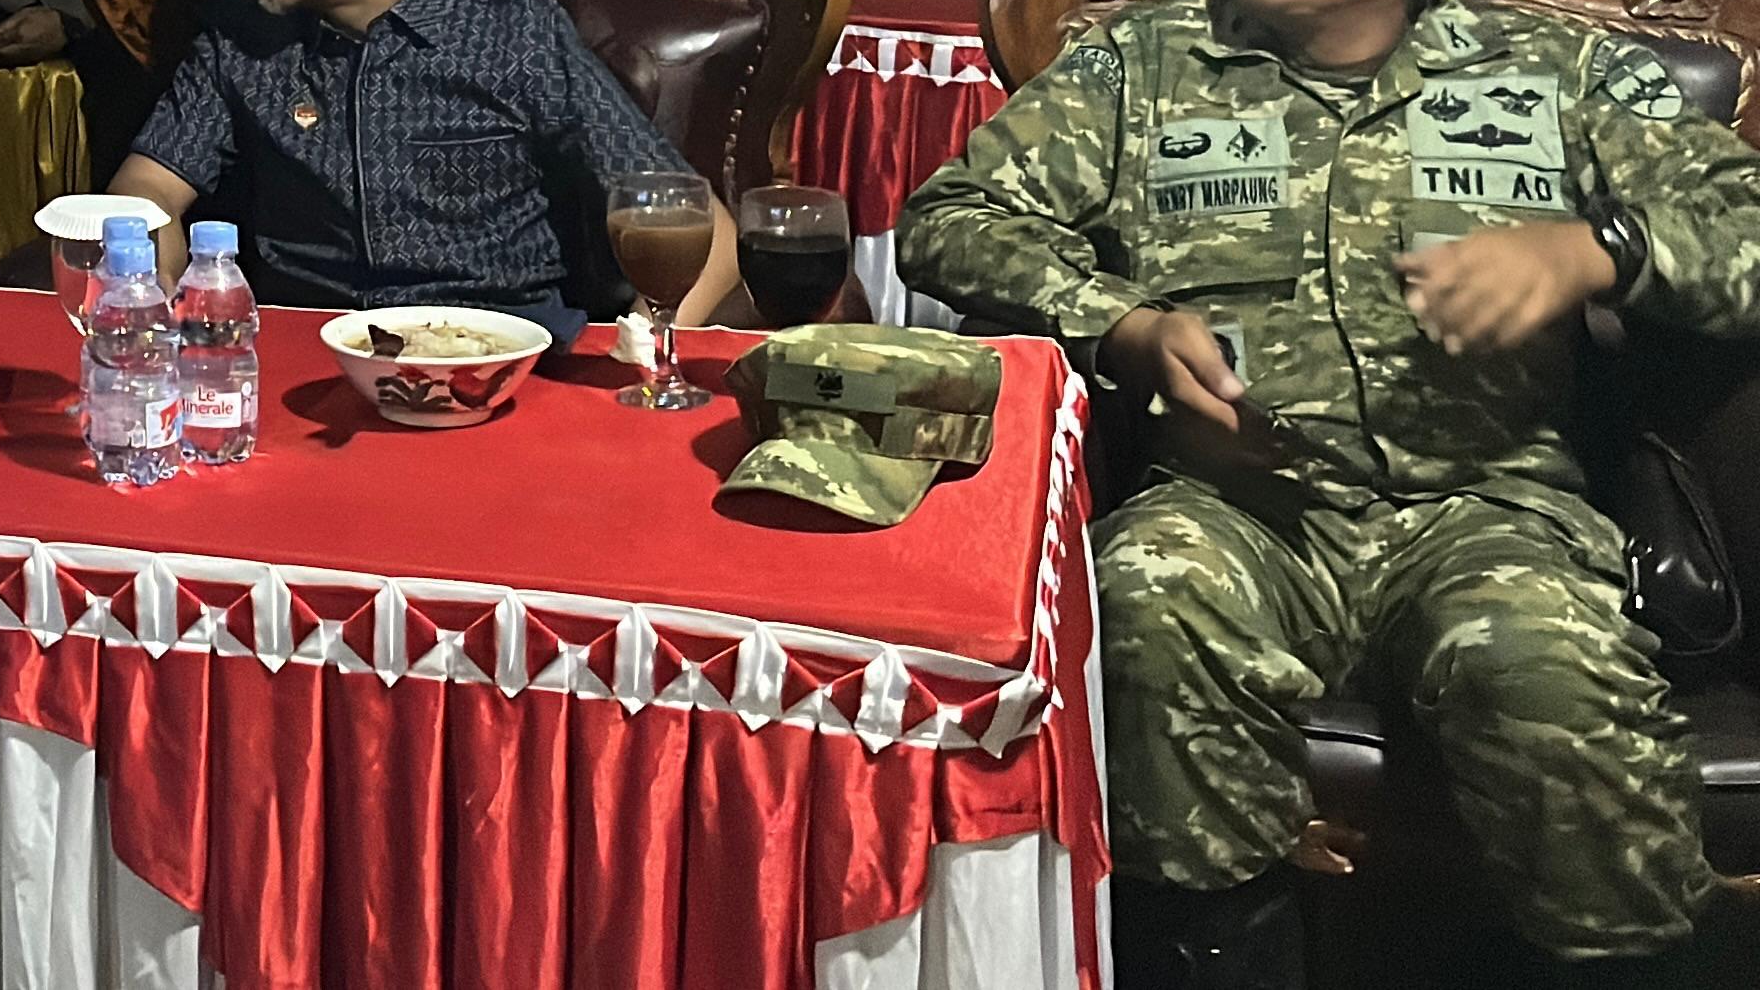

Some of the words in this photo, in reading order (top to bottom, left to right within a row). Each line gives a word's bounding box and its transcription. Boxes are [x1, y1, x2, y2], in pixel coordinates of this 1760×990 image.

[1201, 175, 1279, 208] MARPAUNG
[1421, 167, 1484, 196] TNI
[1512, 172, 1553, 201] AD
[197, 385, 216, 402] Le
